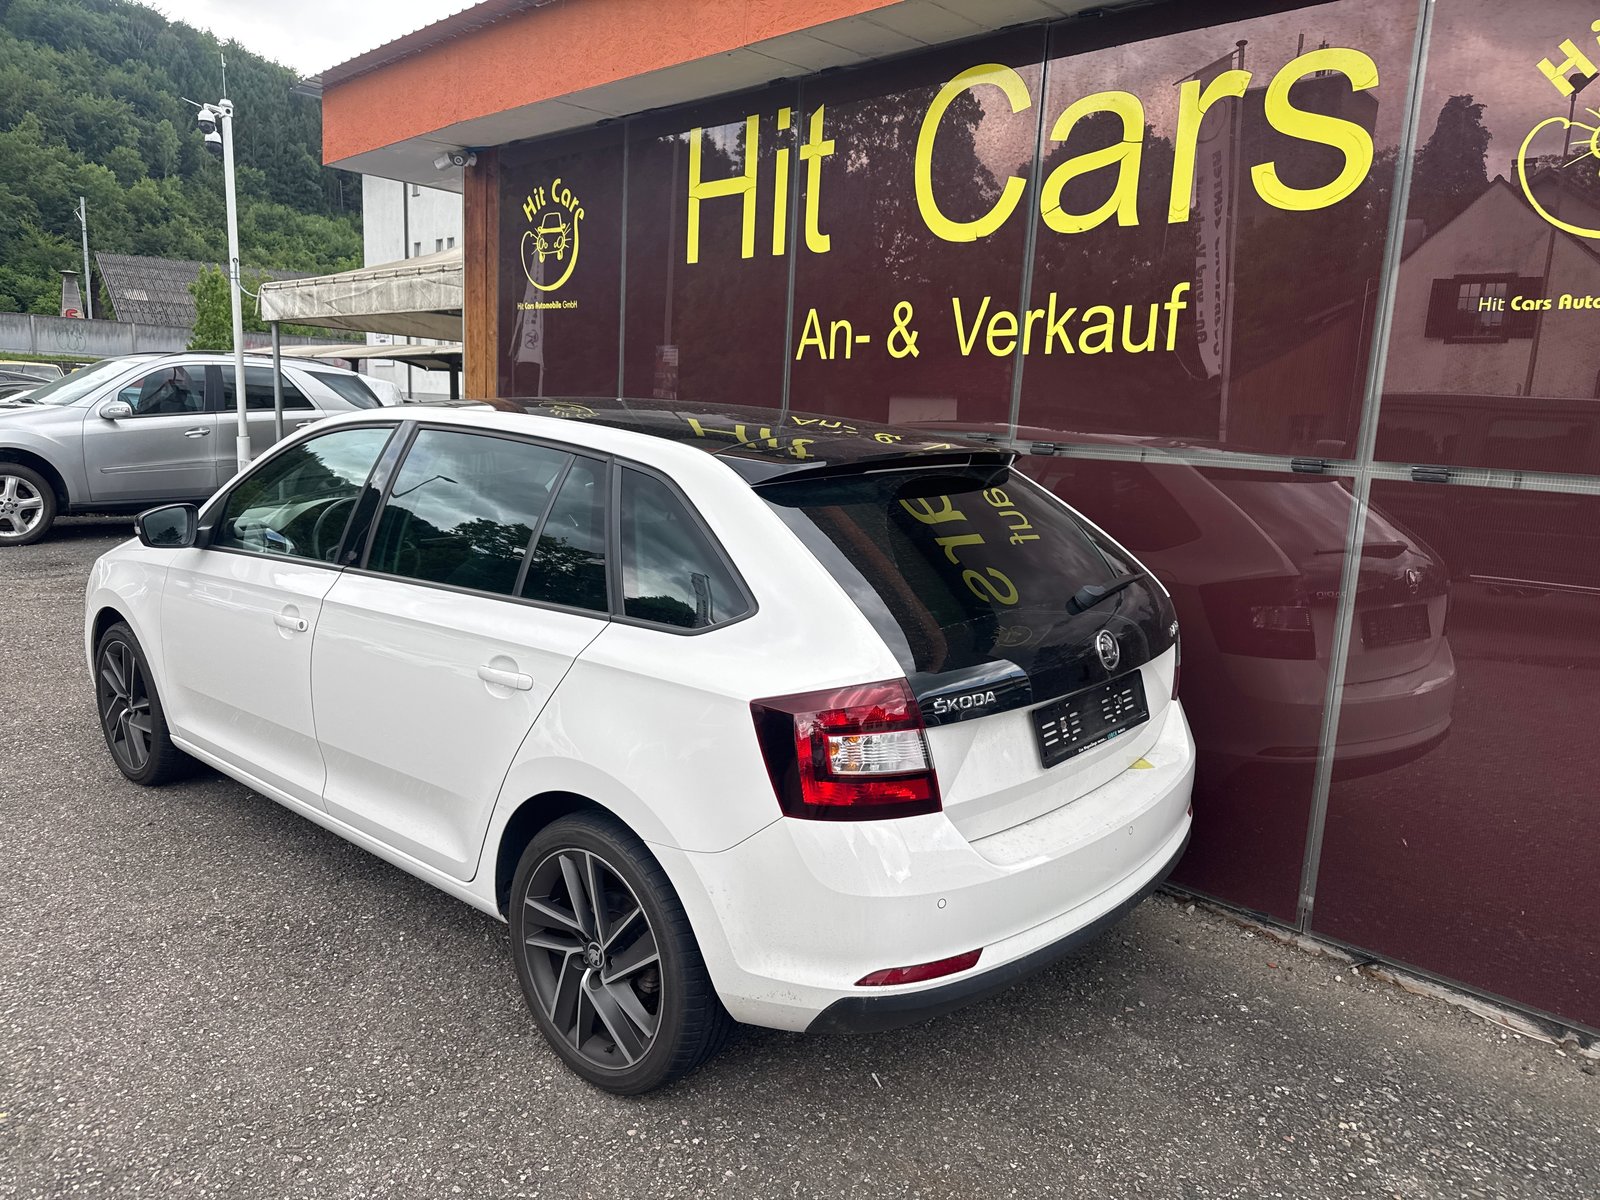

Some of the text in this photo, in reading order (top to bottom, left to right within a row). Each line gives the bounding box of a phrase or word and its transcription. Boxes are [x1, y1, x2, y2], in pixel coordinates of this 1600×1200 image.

[1536, 19, 1600, 97] H
[687, 47, 1380, 264] Hit Cars
[523, 178, 585, 222] Hit Cars
[517, 300, 578, 310] Hit Cars Automobile GmbH
[796, 308, 871, 361] An-
[886, 301, 919, 359] &
[952, 282, 1191, 357] Verkauf
[1478, 297, 1505, 312] Hit
[1510, 295, 1552, 311] Cars
[933, 691, 998, 714] ŠKODA
